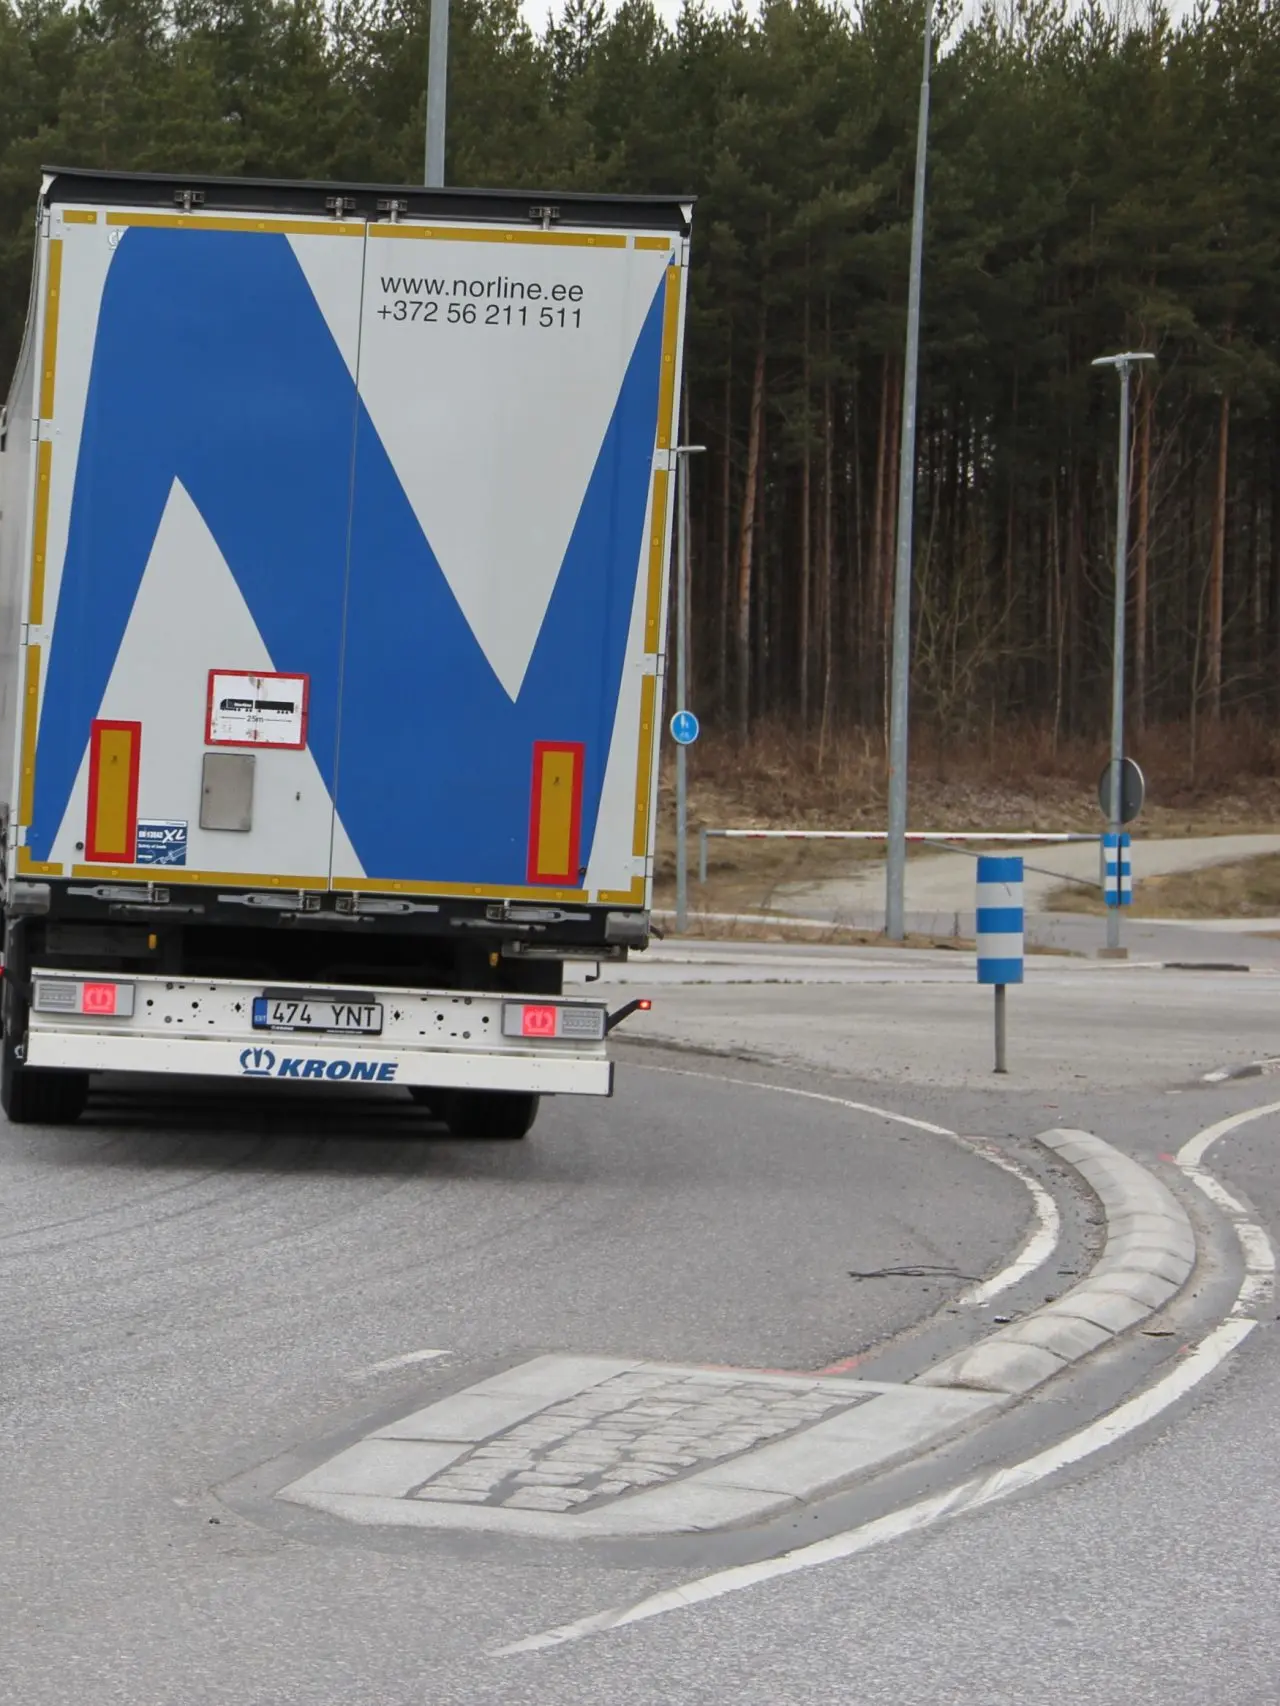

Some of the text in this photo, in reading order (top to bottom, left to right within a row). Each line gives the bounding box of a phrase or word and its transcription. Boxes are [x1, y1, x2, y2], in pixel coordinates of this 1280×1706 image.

[380, 276, 584, 302] www.norline.ee
[377, 300, 581, 328] +372 56 211 511
[162, 829, 186, 843] XL
[272, 1002, 375, 1027] 474 YNT
[277, 1058, 399, 1081] KRONE
